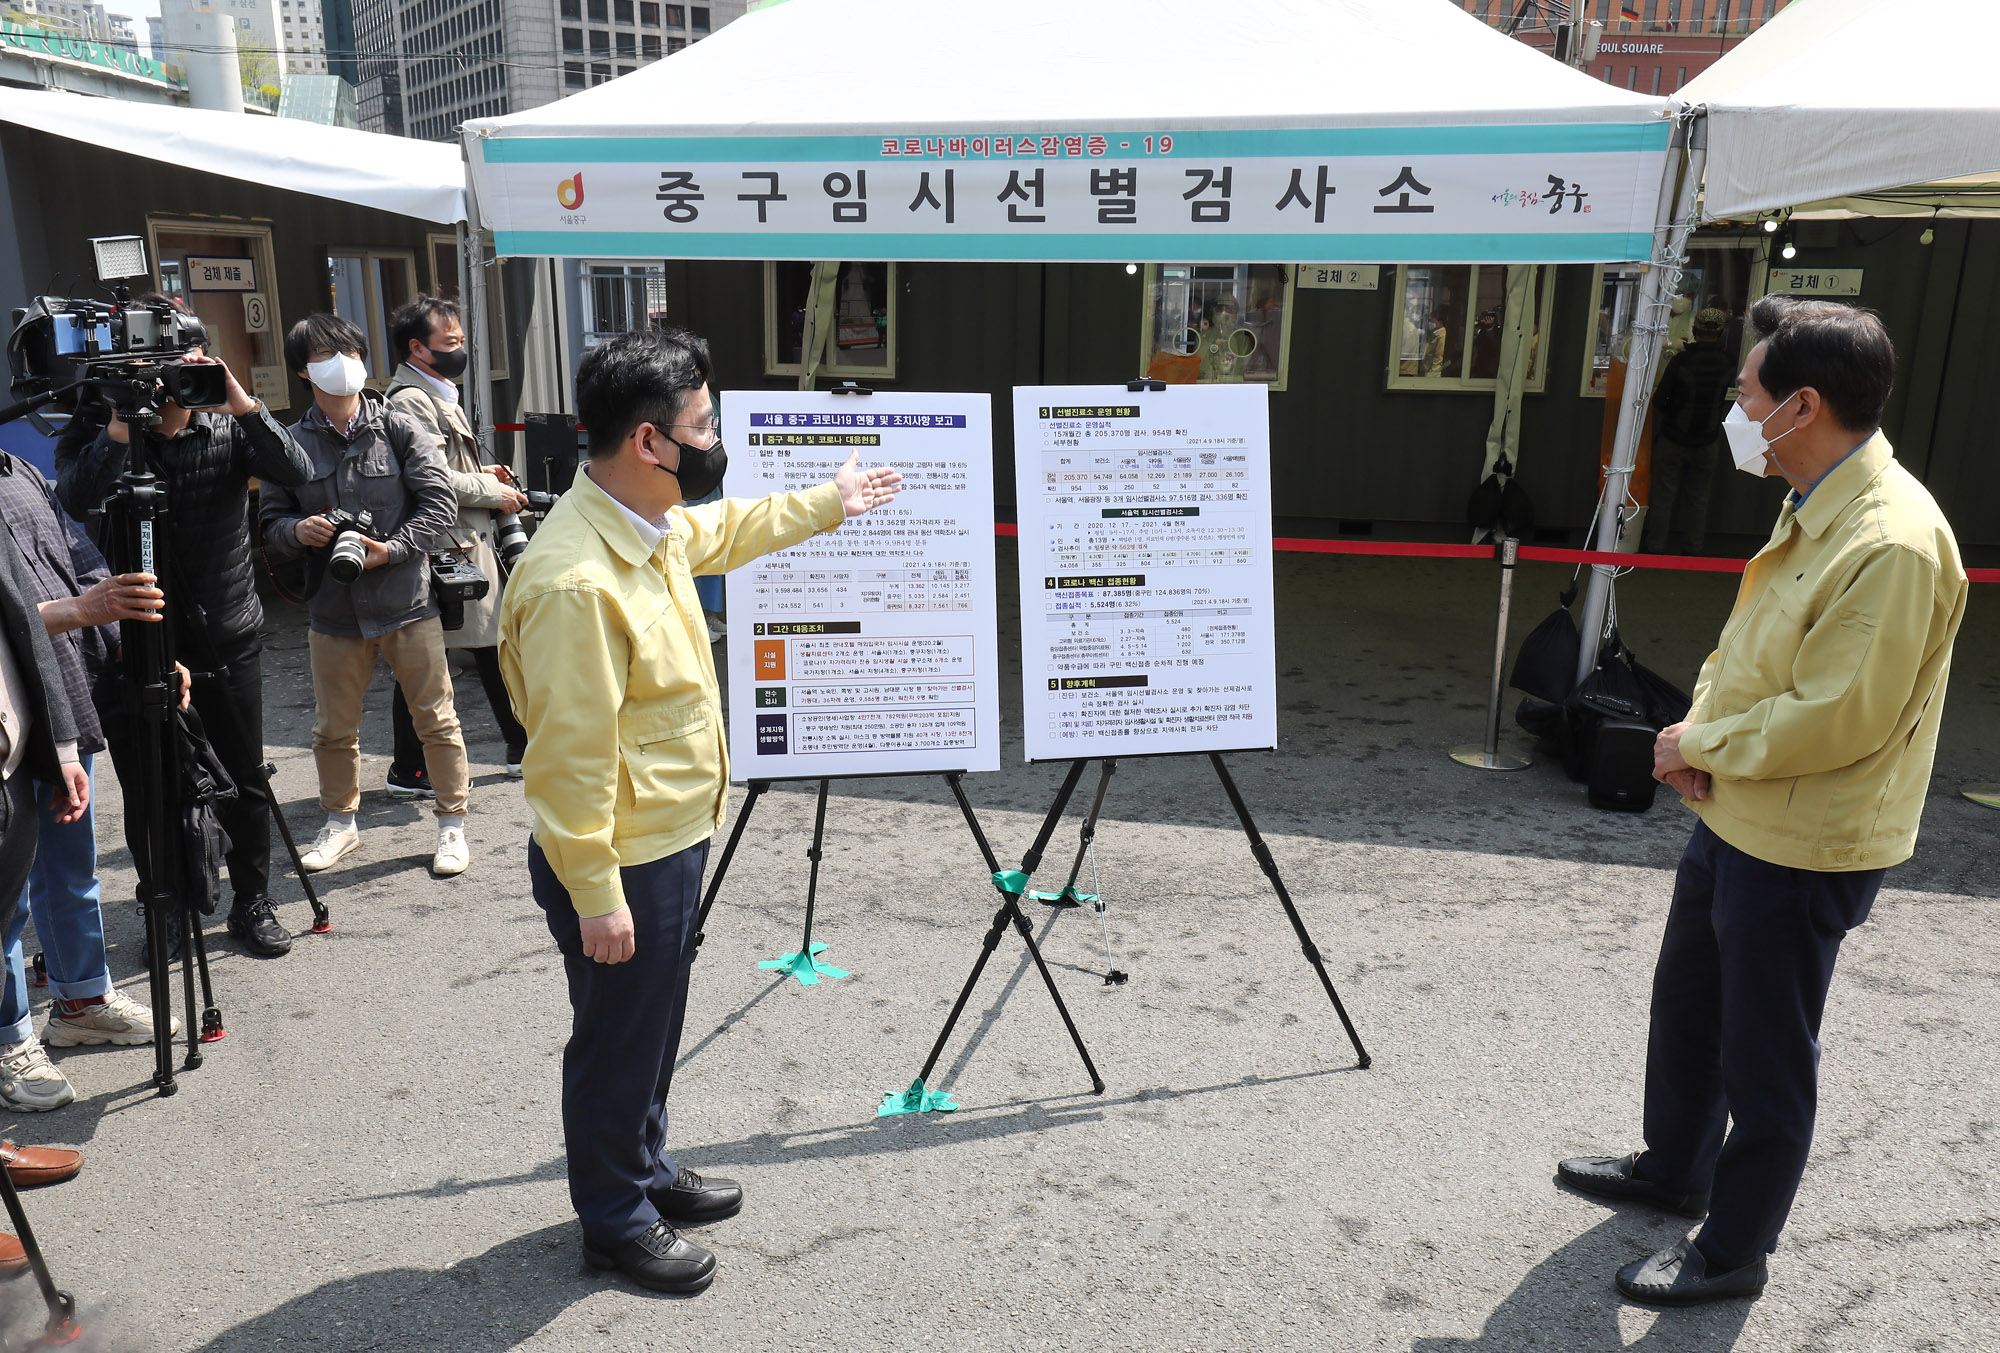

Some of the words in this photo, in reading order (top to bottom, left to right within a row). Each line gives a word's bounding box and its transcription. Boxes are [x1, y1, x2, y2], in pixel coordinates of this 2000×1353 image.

[1597, 43, 1620, 53] EOUL
[1621, 43, 1664, 54] SQUARE
[881, 136, 1107, 157] 코로나바이러스감염증
[1143, 135, 1173, 155] 19
[1542, 174, 1588, 214] 중구
[560, 215, 587, 225] 서울중구
[203, 267, 221, 281] 검체
[224, 267, 241, 281] 제출
[1317, 270, 1342, 283] 검체
[1790, 275, 1819, 289] 검체
[1098, 408, 1112, 416] 운영
[1116, 408, 1130, 416] 현황
[764, 415, 783, 425] 서울
[789, 415, 807, 425] 중구
[813, 415, 851, 425] 코로나19
[857, 415, 875, 425] 현황
[880, 416, 888, 425] 및
[894, 416, 930, 426] 조치사항
[935, 417, 953, 426] 보고
[768, 436, 783, 444] 중구
[787, 436, 802, 444] 특성
[807, 436, 814, 444] 및
[819, 436, 841, 444] 코로나
[846, 436, 877, 444] 대응현황
[142, 522, 152, 568] 국제감시단
[1089, 578, 1103, 586] 백신
[1107, 577, 1136, 586] 접종현황
[757, 625, 762, 633] 2
[773, 625, 788, 633] 그간
[793, 625, 824, 633] 대응조치
[1066, 679, 1095, 688] 향후계획
[1127, 689, 1168, 697] 임시선별검사소
